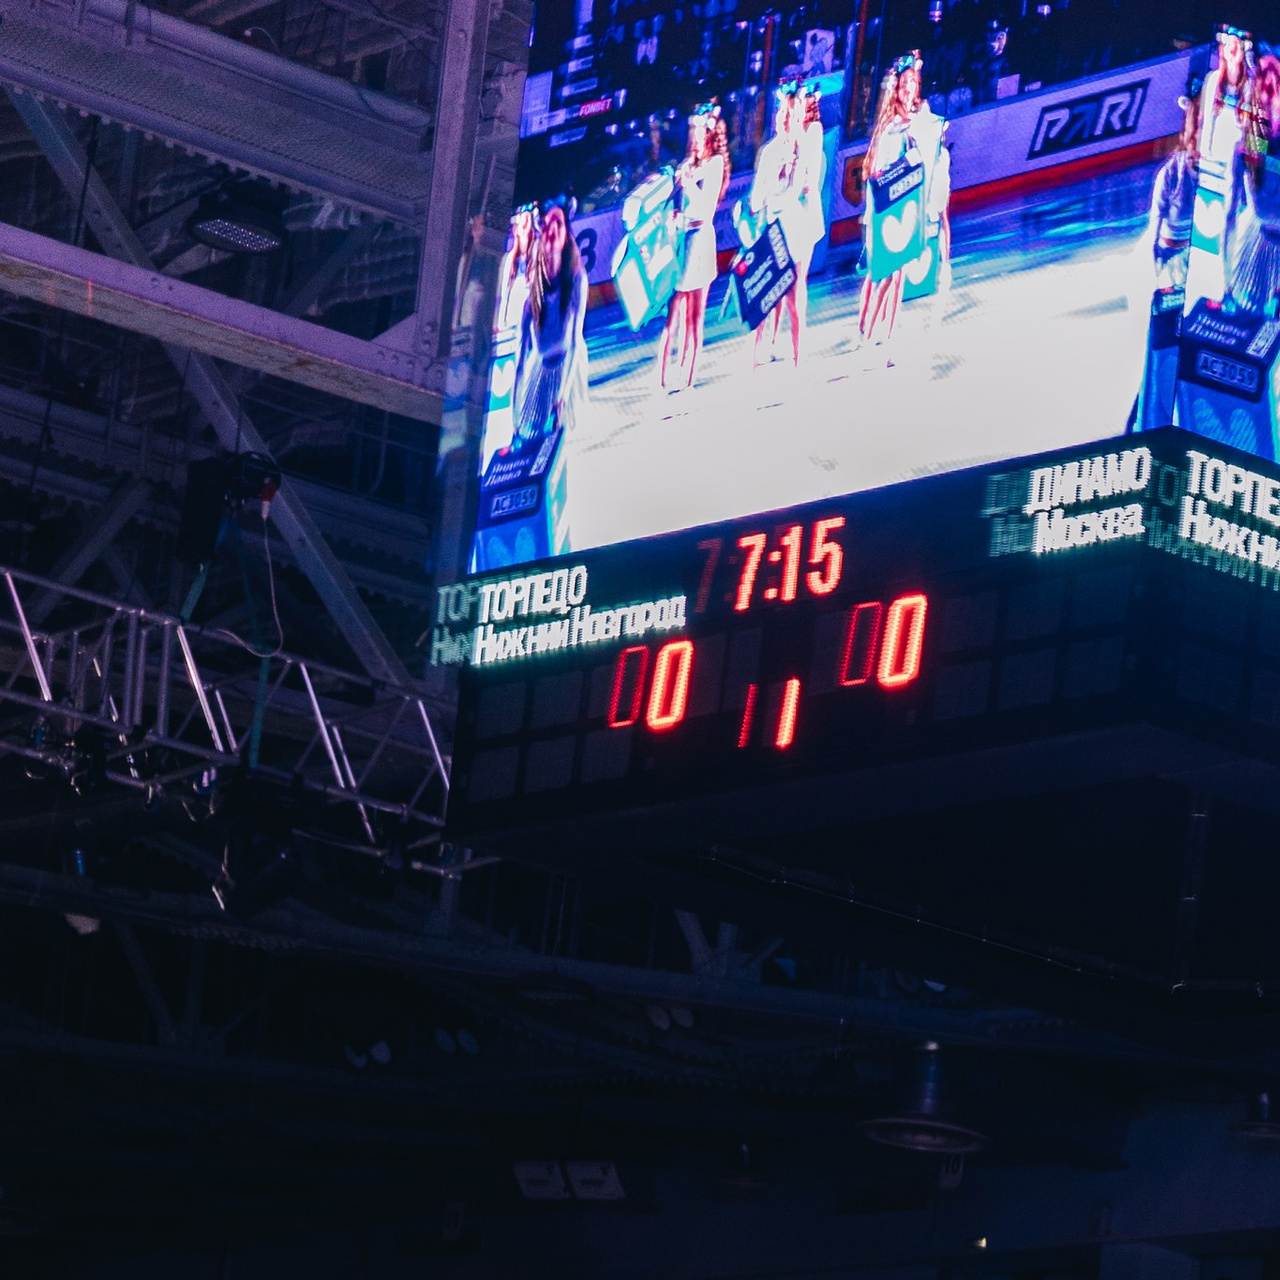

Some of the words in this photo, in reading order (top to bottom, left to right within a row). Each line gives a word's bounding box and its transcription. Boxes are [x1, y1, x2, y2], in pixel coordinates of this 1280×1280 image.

[1034, 88, 1143, 150] PARI
[1022, 447, 1152, 515] ДИНАМО
[1032, 503, 1146, 553] Москва
[479, 565, 588, 624] ТОРПЕДО
[735, 517, 846, 612] 7:15
